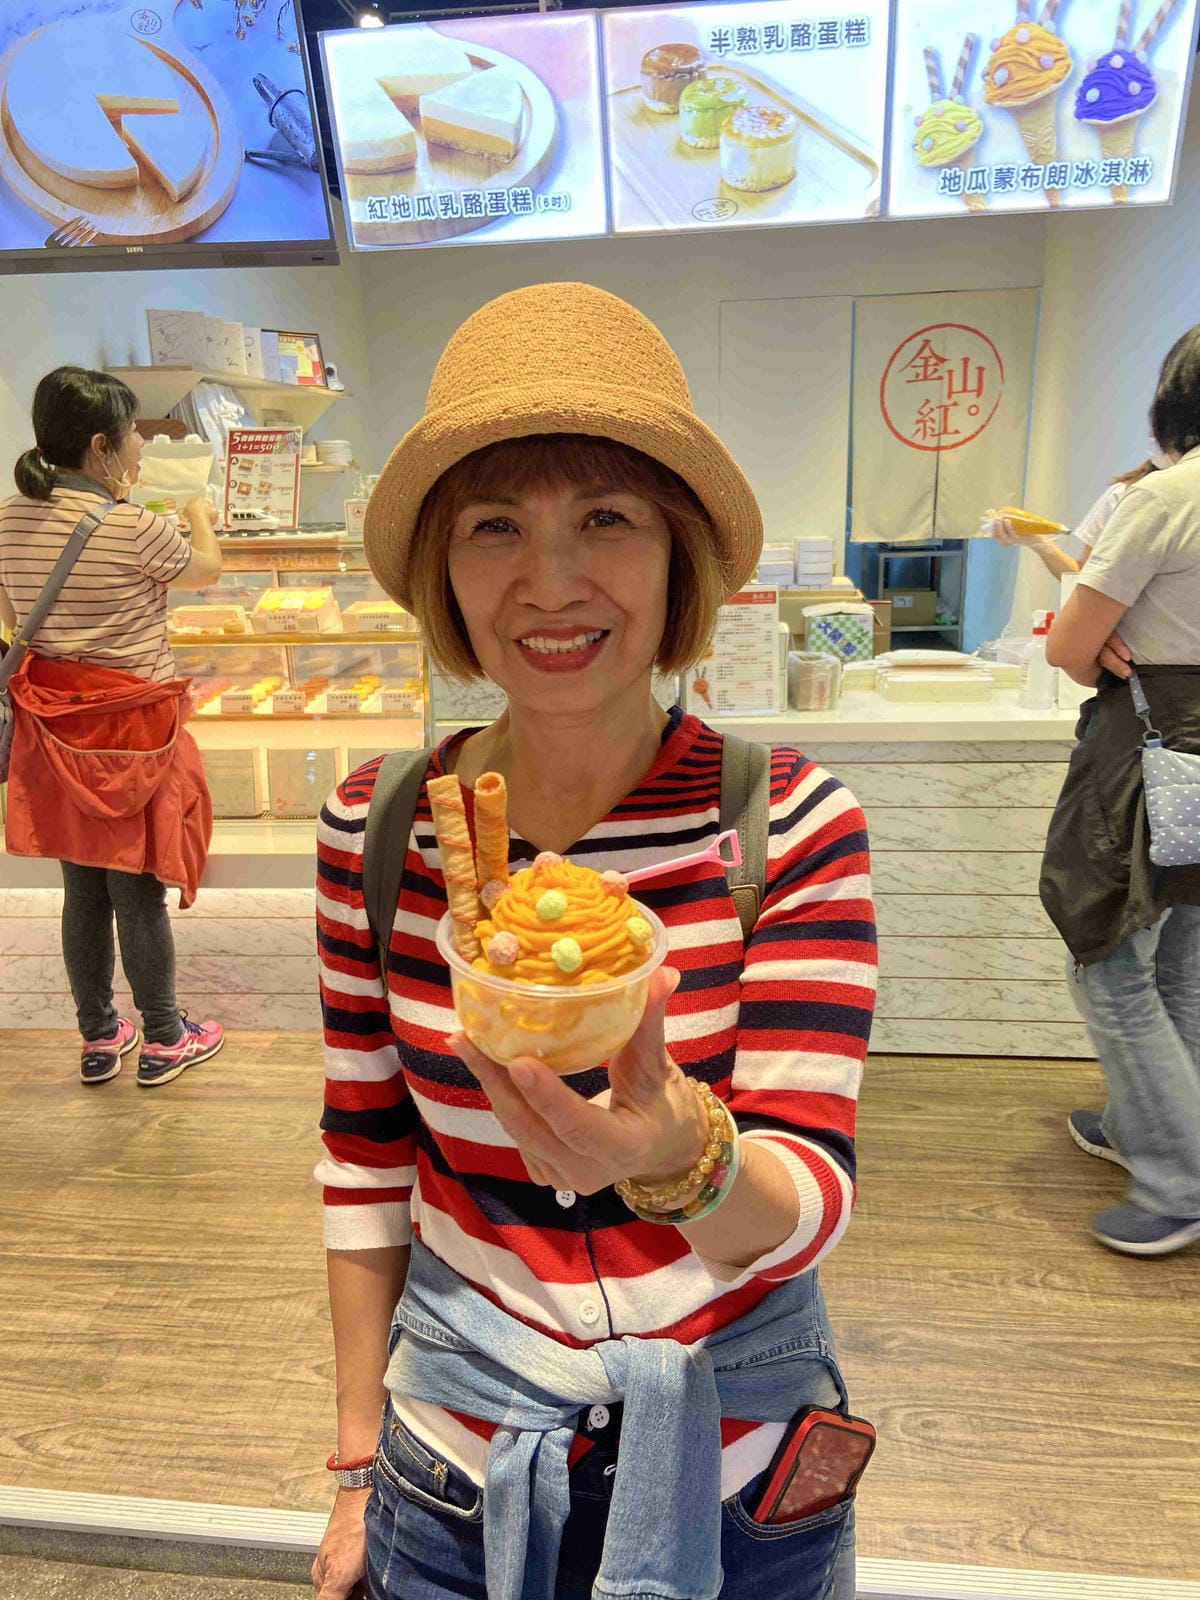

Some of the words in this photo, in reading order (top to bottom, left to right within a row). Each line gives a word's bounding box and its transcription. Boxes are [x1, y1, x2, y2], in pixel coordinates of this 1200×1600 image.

[710, 18, 866, 53] 半熟乳酪蛋糕
[940, 158, 1150, 193] 地瓜蒙布朗冰淇淋
[368, 189, 533, 220] 紅地瓜乳酪蛋糕
